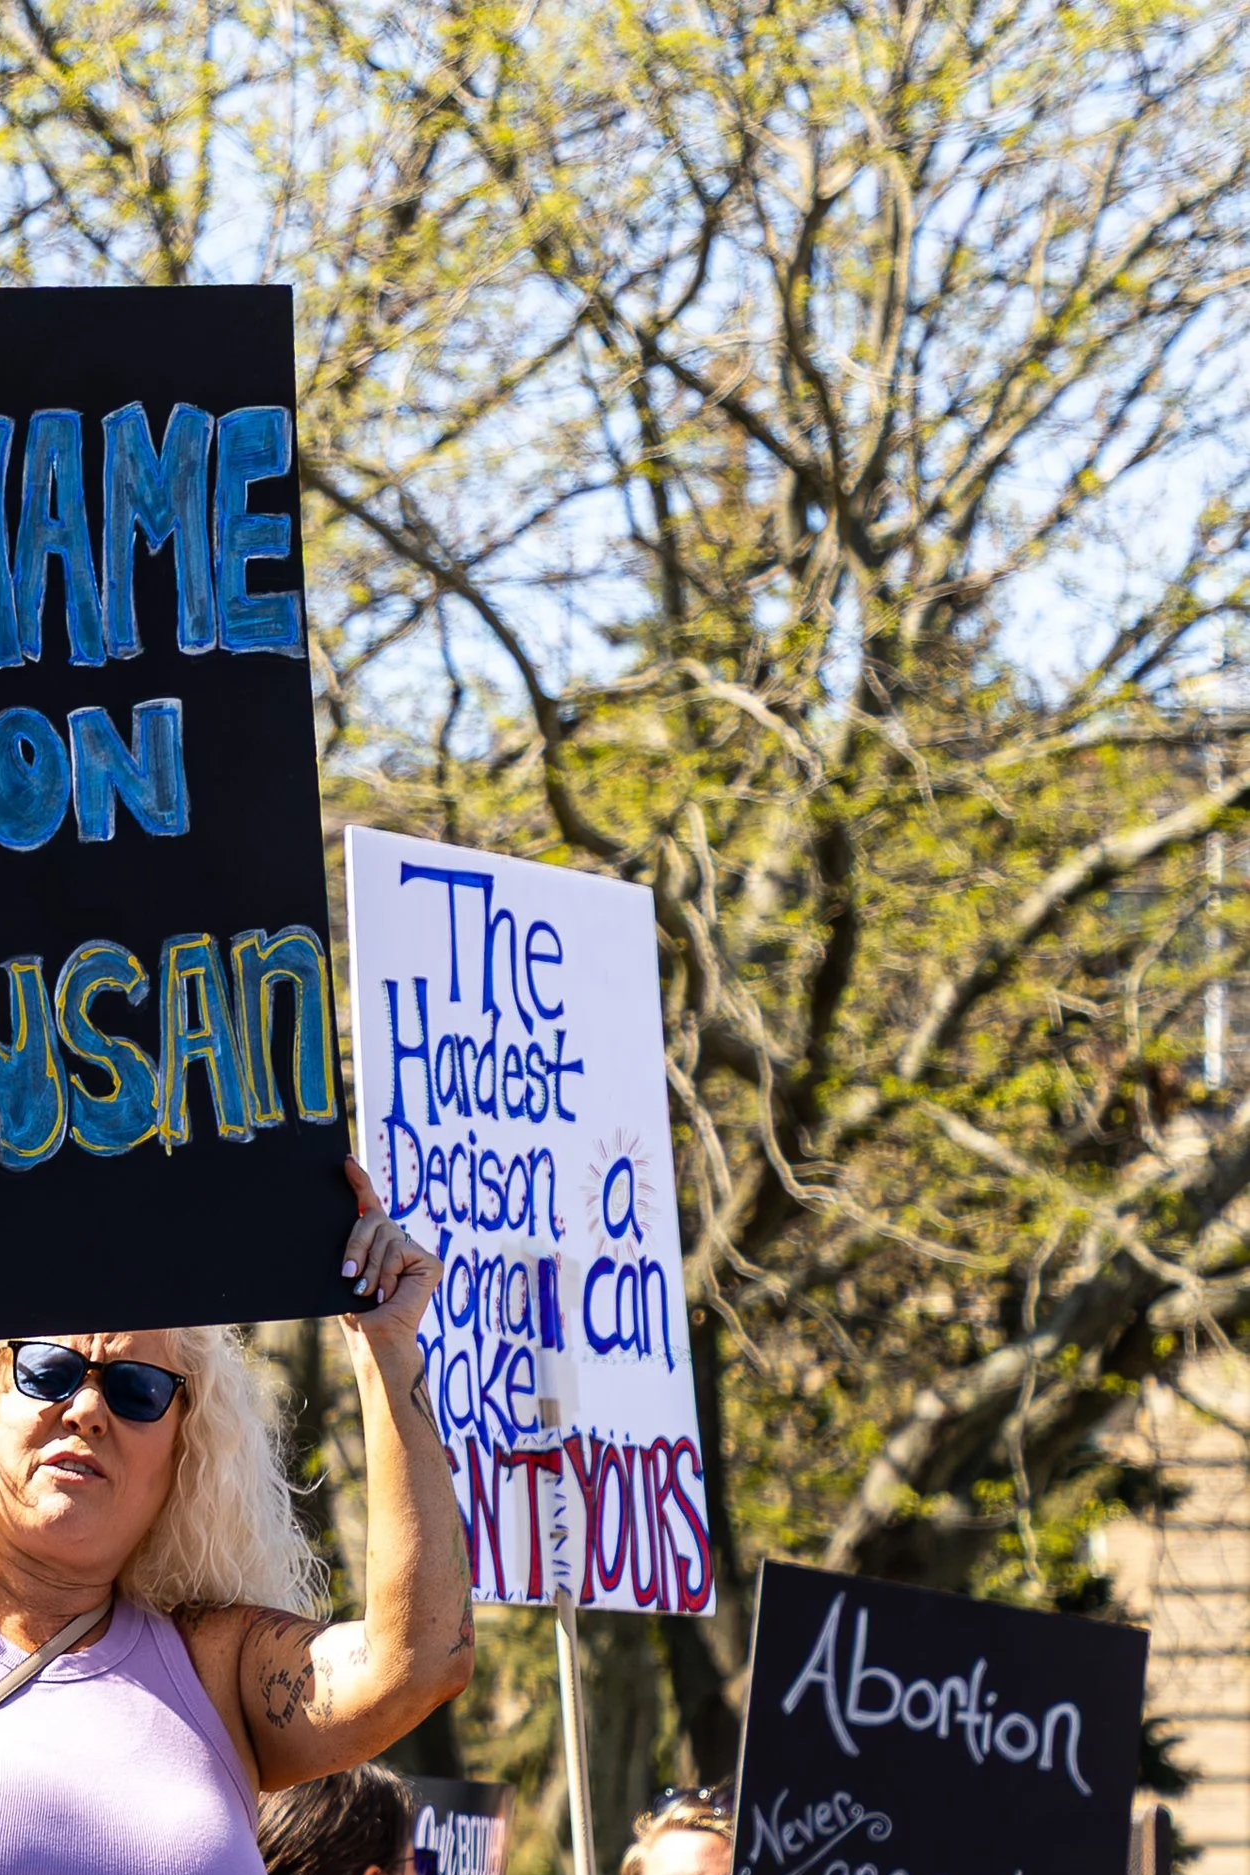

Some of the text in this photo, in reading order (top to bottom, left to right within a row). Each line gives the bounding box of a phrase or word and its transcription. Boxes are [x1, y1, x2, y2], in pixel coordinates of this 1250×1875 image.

[400, 861, 565, 1036] The
[382, 976, 585, 1126] Hardest
[382, 1115, 644, 1245] Decison a
[582, 1253, 676, 1374] can
[563, 1432, 714, 1613] YOURS
[781, 1590, 1092, 1796] Abortion
[749, 1787, 858, 1865] Never
